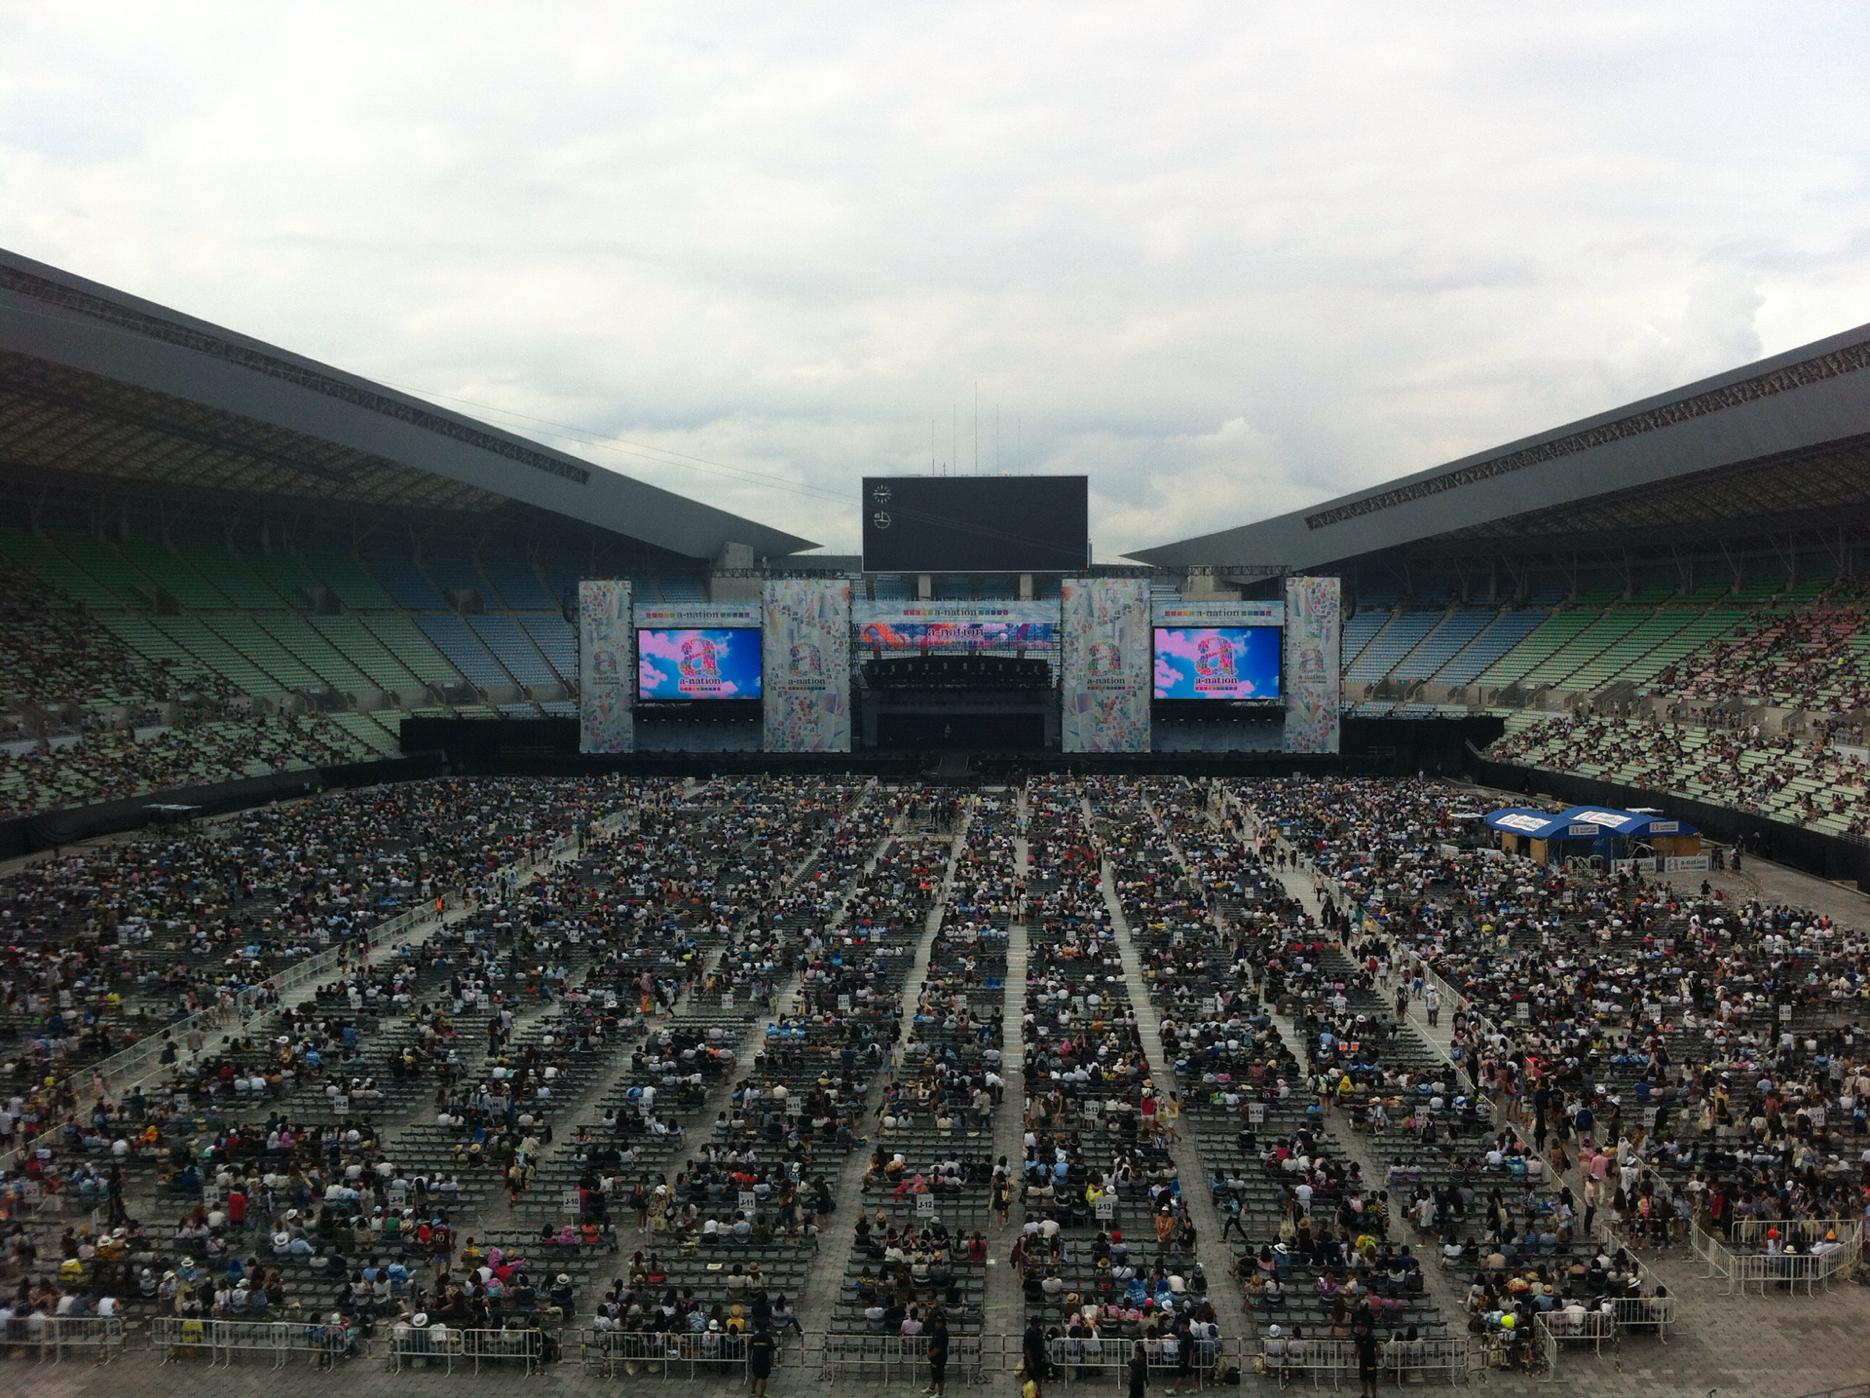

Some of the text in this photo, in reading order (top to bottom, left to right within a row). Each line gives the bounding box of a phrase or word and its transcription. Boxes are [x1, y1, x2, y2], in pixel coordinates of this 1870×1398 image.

[677, 610, 719, 619] a-nation
[934, 609, 977, 617] a-nation
[1196, 609, 1240, 617] a-nation
[928, 627, 984, 637] a-nation
[679, 676, 721, 686] a-nation
[787, 677, 826, 686] a-nation
[1087, 676, 1126, 684] a-nation
[1195, 676, 1238, 684] a-nation
